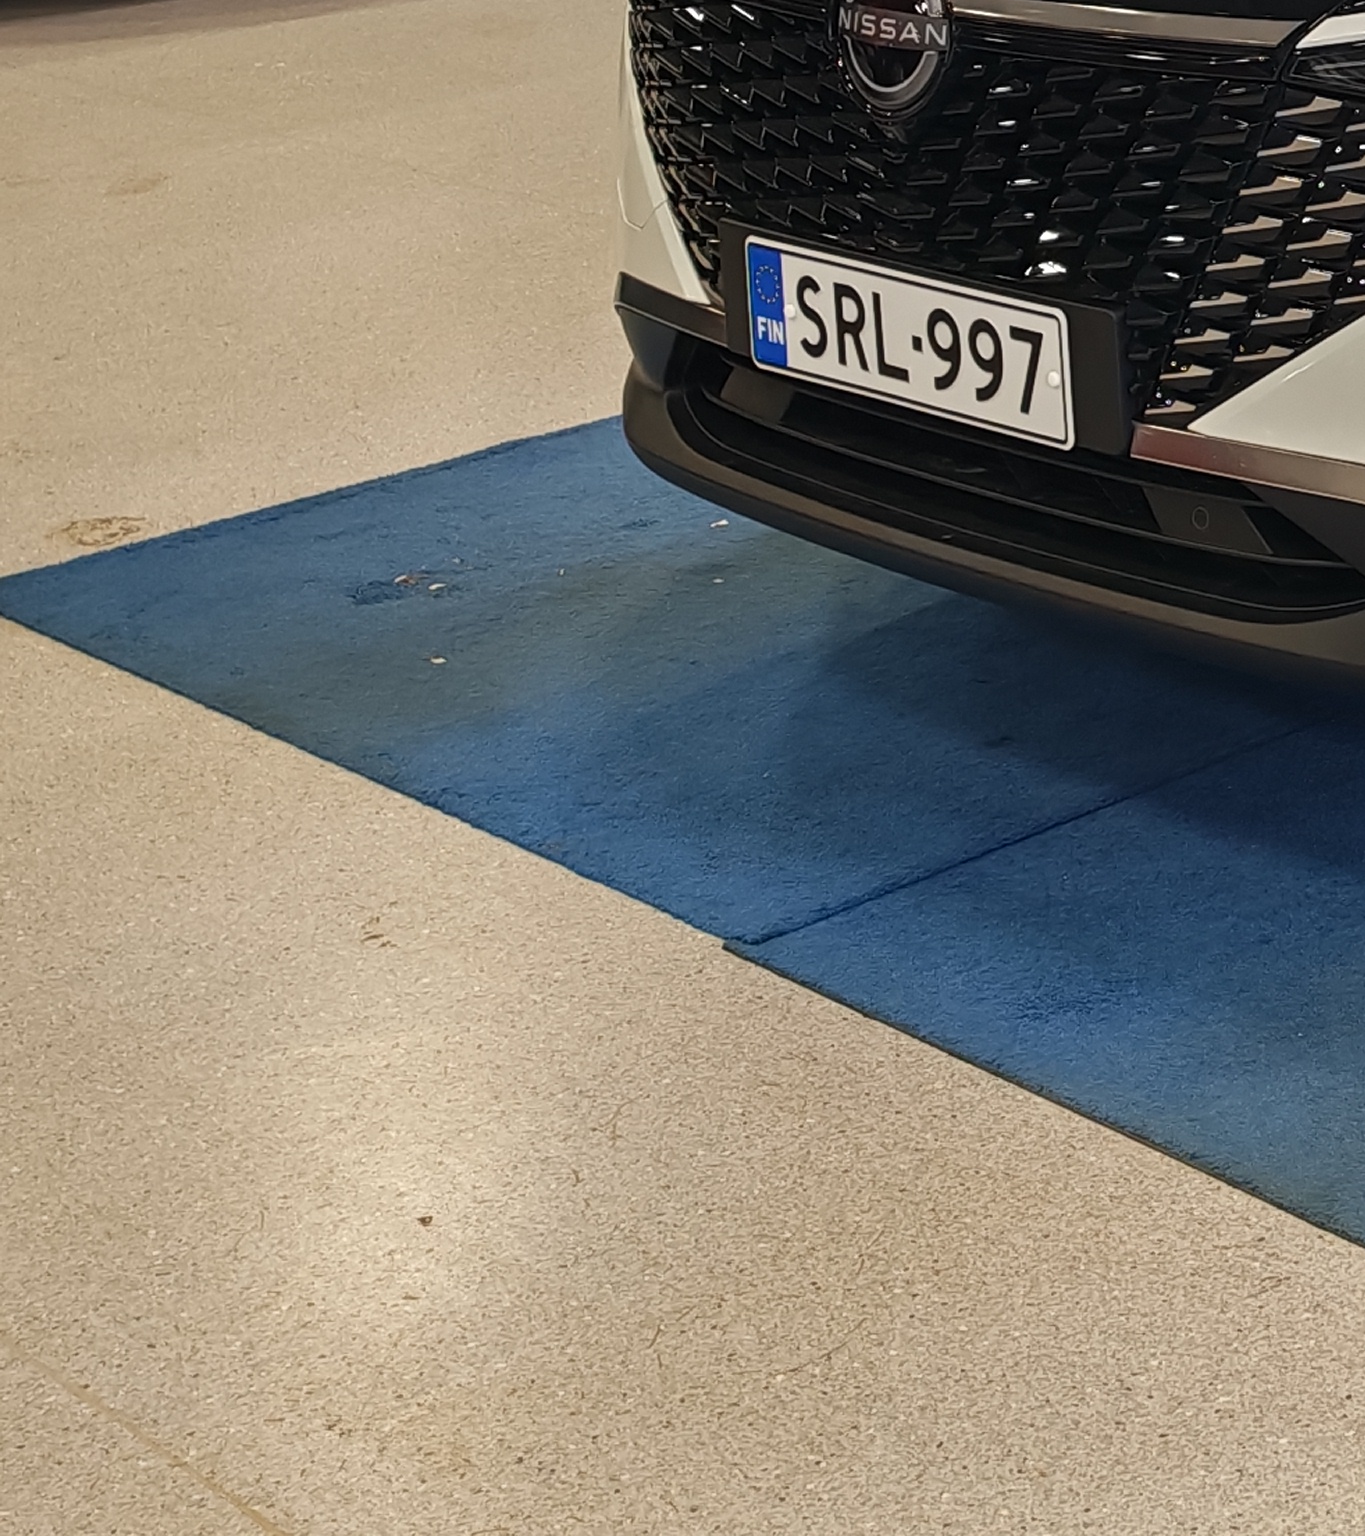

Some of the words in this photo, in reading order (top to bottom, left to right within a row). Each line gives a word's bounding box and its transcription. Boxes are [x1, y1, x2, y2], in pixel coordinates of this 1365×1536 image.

[839, 6, 947, 46] NISSAN
[756, 316, 785, 346] FIN
[798, 274, 1046, 416] SRL-997
